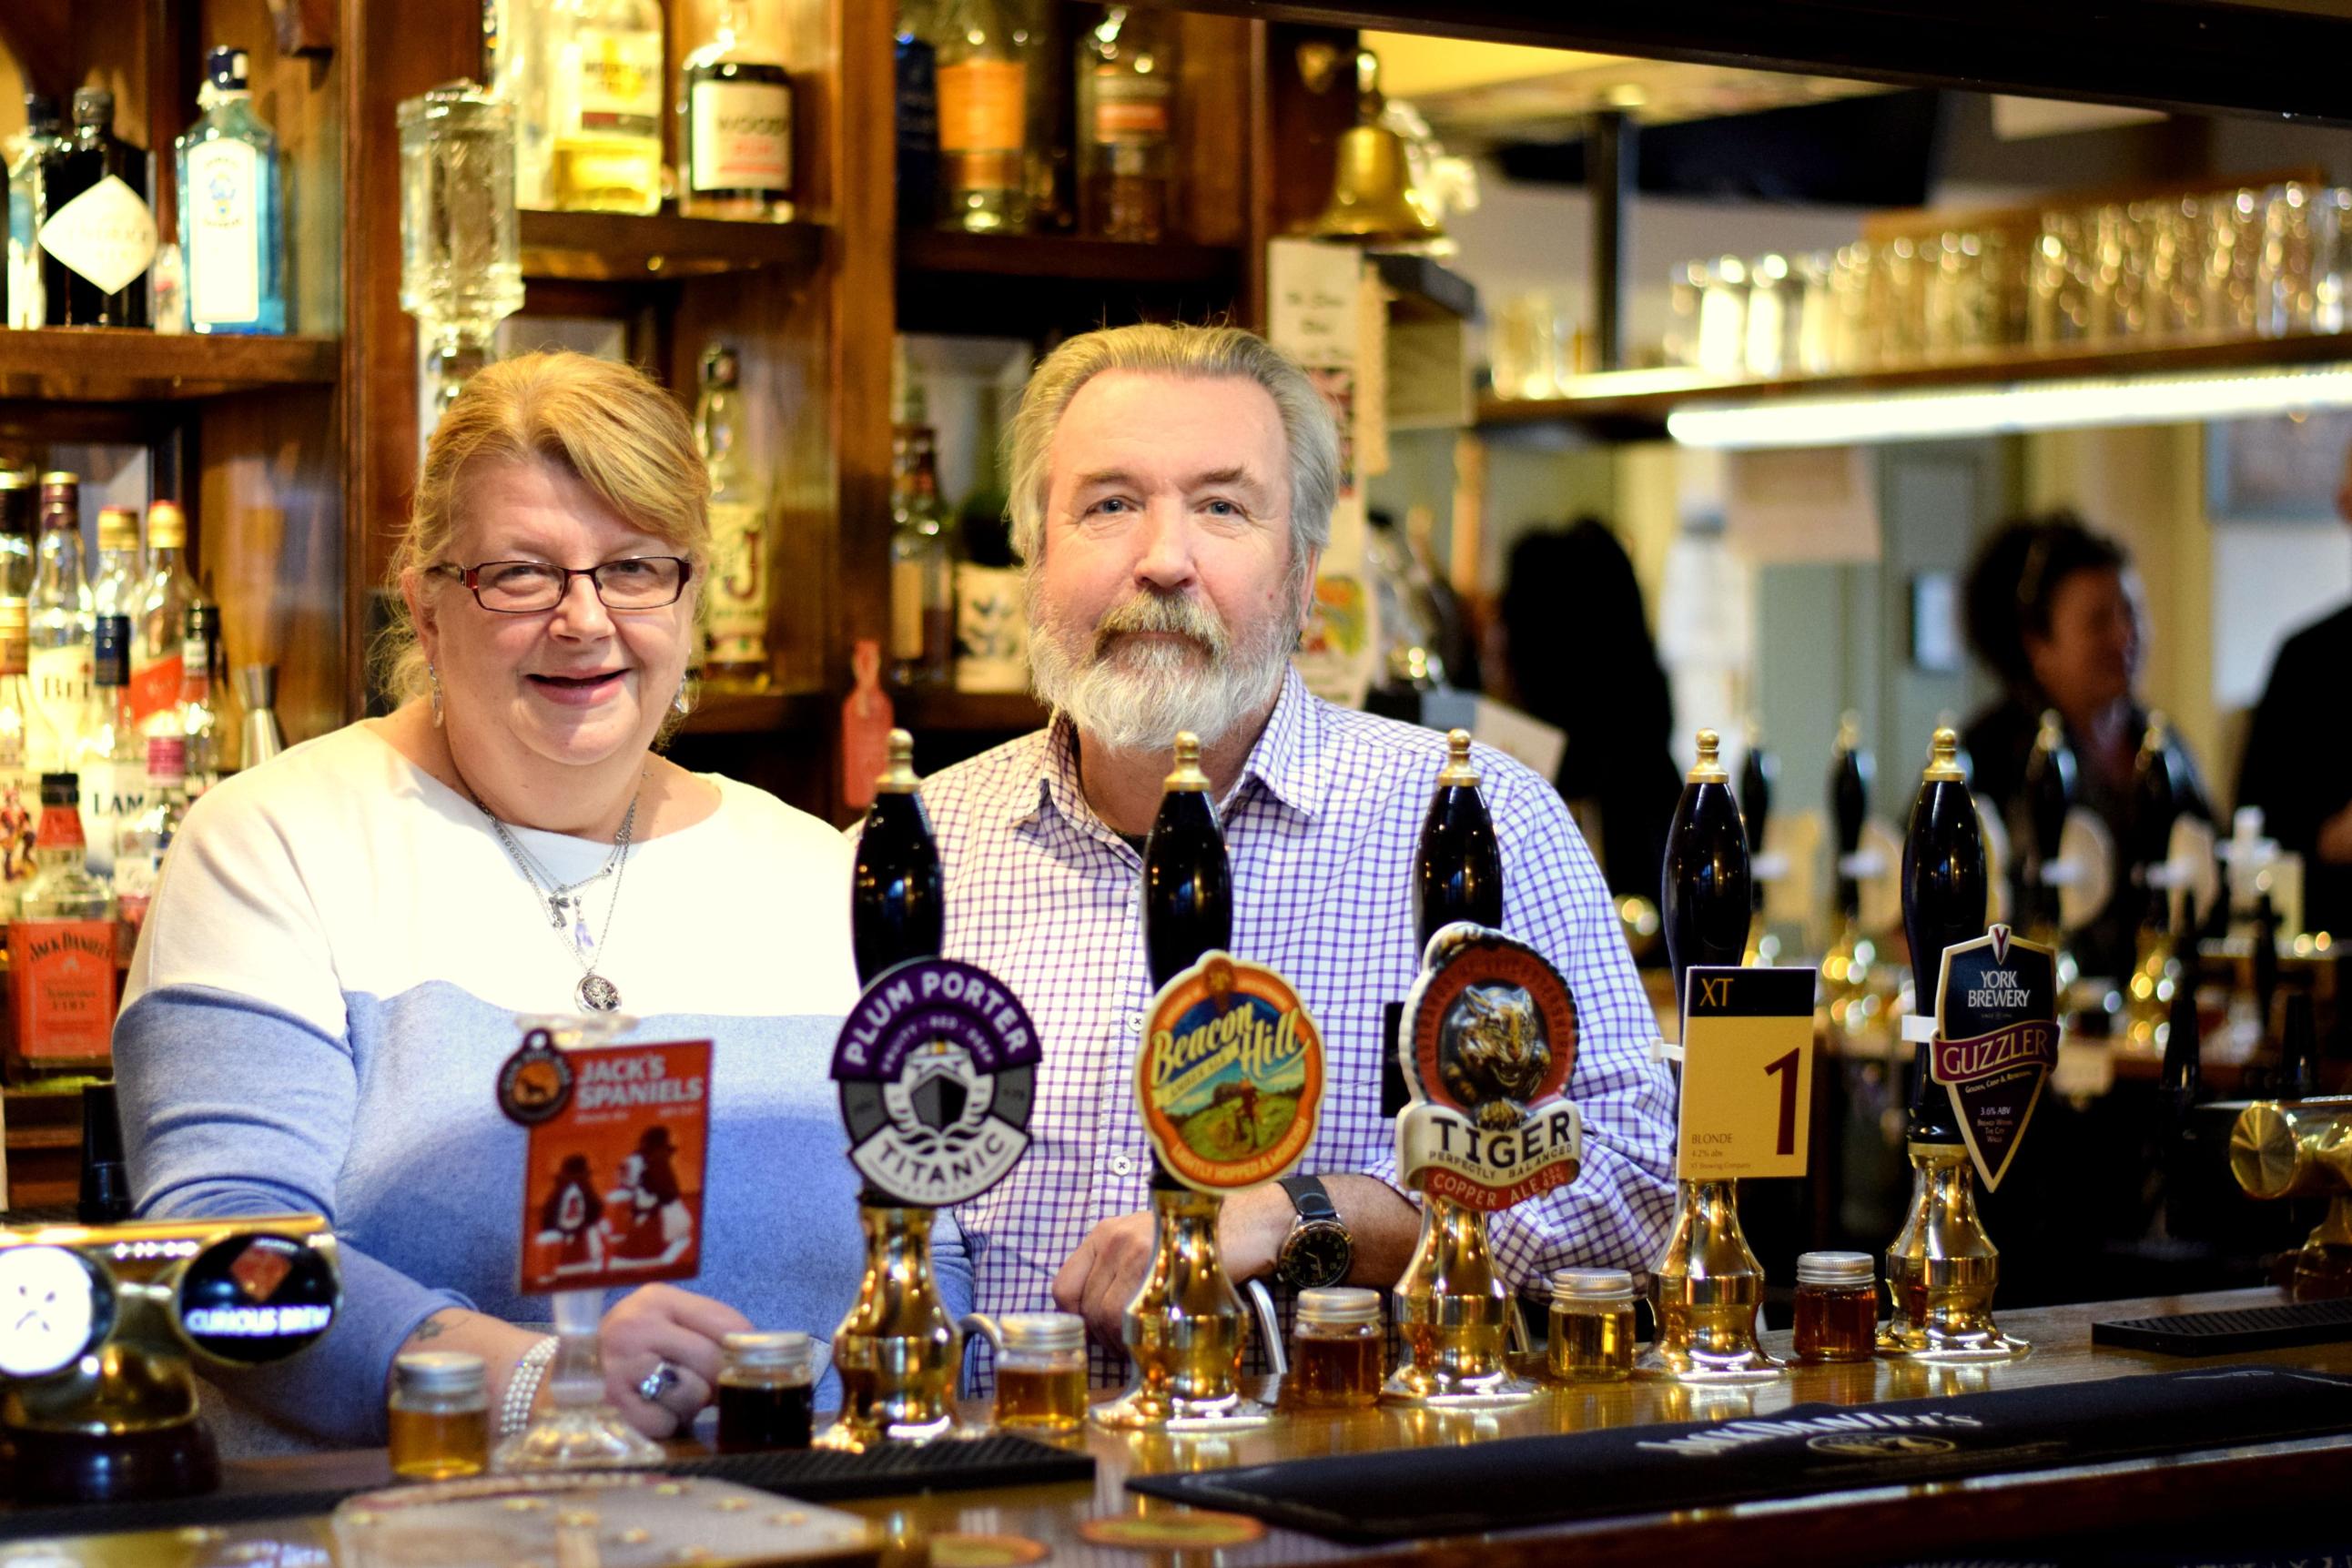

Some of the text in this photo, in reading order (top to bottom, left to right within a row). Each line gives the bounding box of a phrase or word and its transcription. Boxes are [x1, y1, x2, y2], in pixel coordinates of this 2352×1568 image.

[1699, 977, 1734, 1007] XT
[1981, 970, 2018, 988] YORK
[1967, 989, 2031, 1007] BREWERY
[842, 971, 1029, 1067] PLUM PORTER
[1151, 1001, 1254, 1087] Beacon
[1239, 1006, 1303, 1080] Hill
[1942, 1028, 2049, 1076] GUZZLER
[578, 1053, 666, 1084] JACK'S
[577, 1077, 704, 1110] SPANIELS
[1763, 1047, 1800, 1156] 1
[1997, 1106, 2012, 1116] ABV
[1430, 1110, 1571, 1168] TIGER
[1691, 1132, 1734, 1145] BLONDE
[878, 1132, 1006, 1185] TITANIC
[1428, 1143, 1573, 1180] PERFECTLY BALANCED
[1433, 1172, 1498, 1208] COPPER
[1510, 1179, 1541, 1204] ALE
